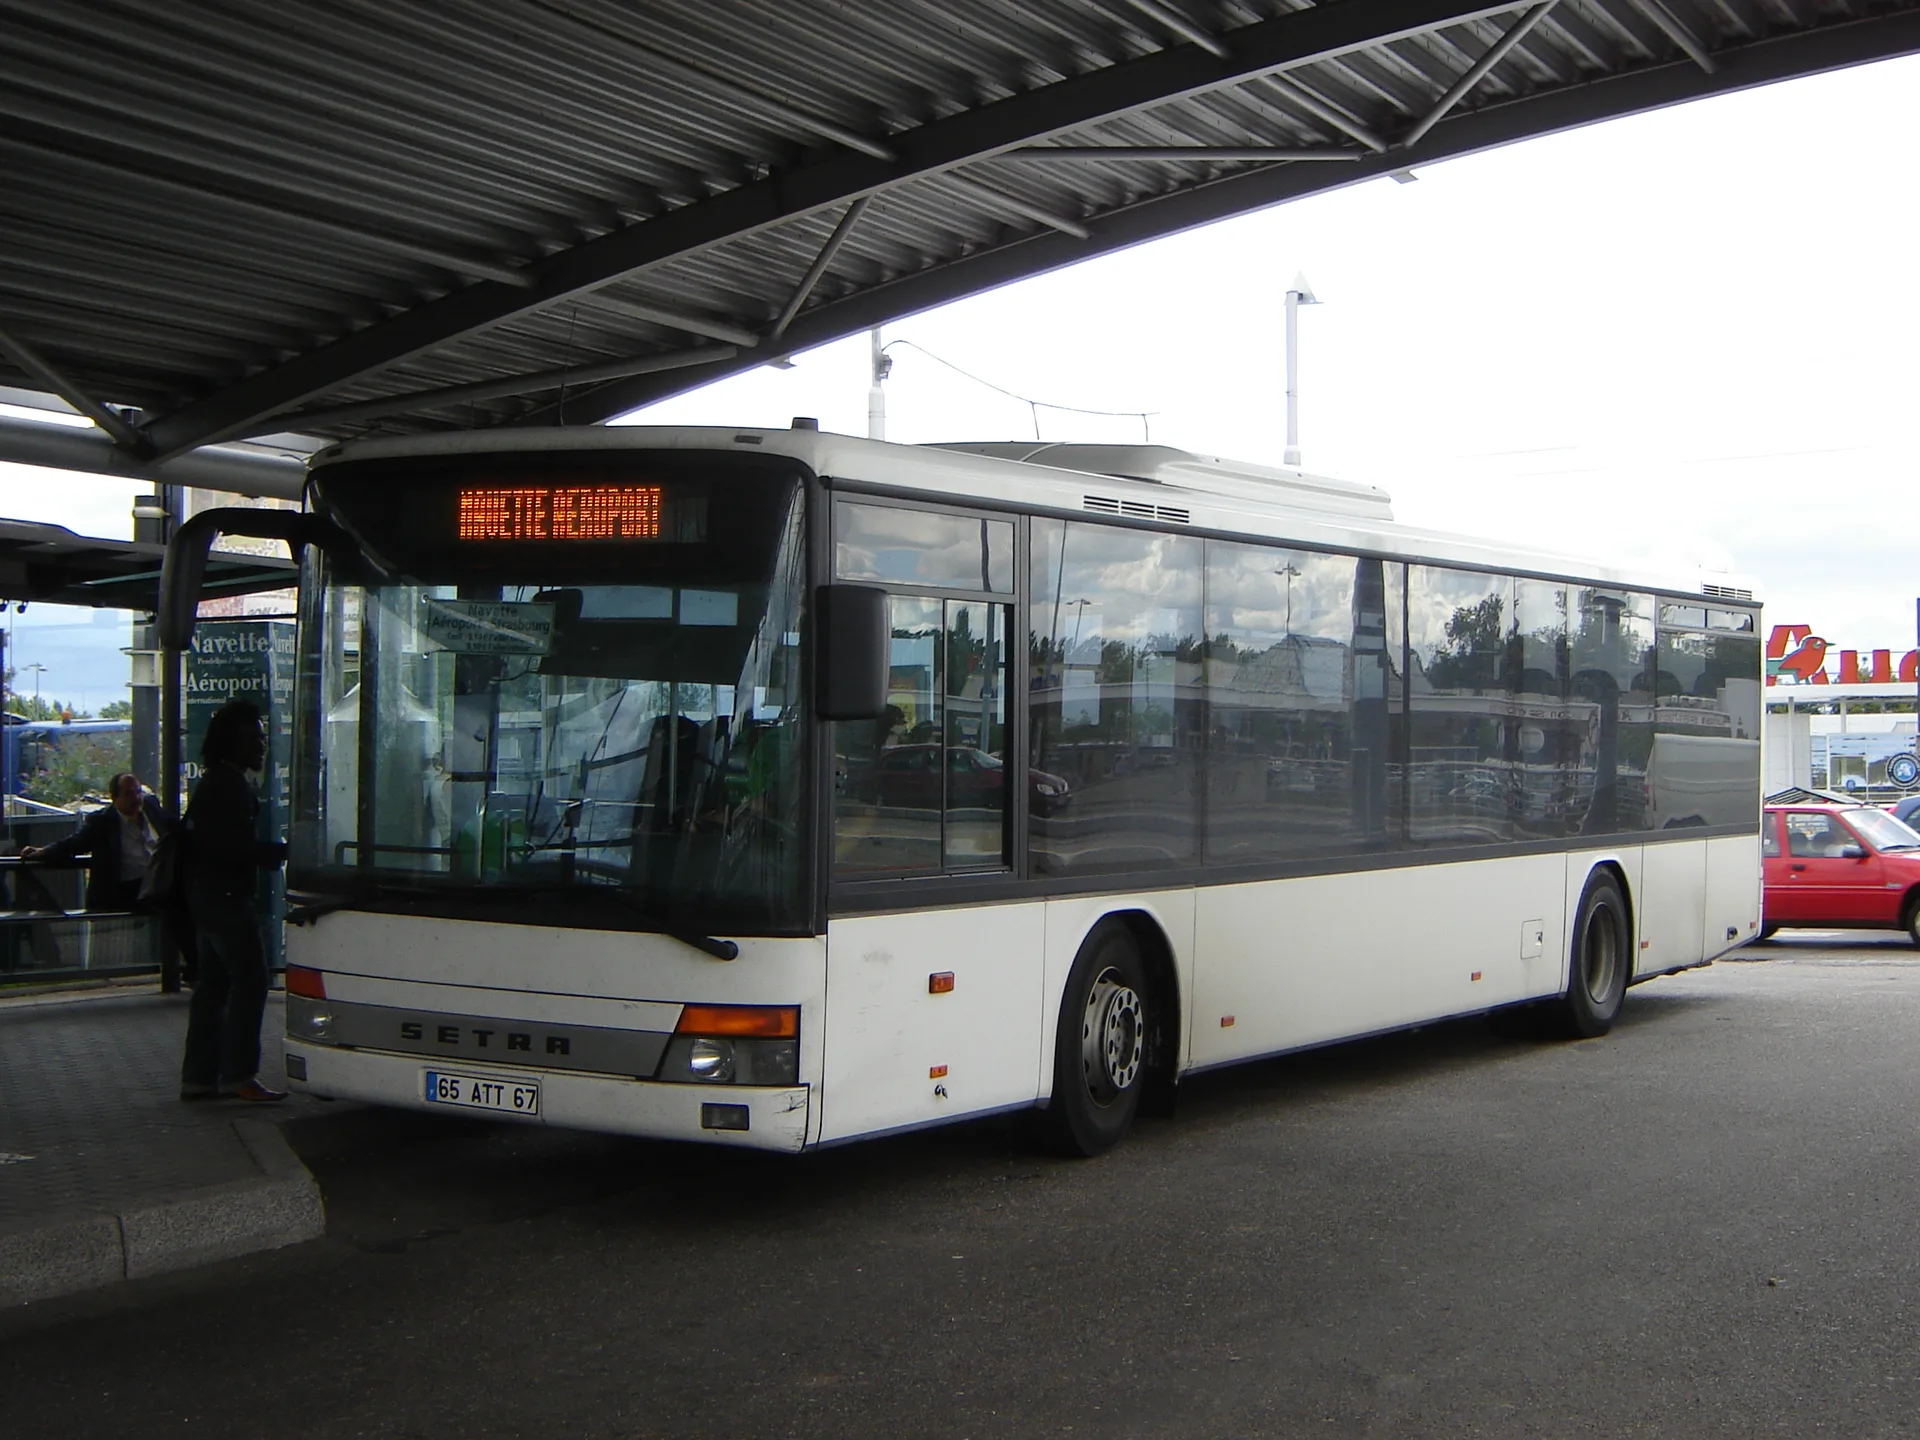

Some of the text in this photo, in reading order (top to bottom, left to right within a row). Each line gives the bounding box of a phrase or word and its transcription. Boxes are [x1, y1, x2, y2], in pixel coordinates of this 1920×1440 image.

[460, 486, 661, 539] NAVETTE AEROPORT
[468, 604, 518, 617] Navette
[191, 630, 269, 654] Navette
[187, 672, 269, 698] Aéroport
[401, 1022, 570, 1055] SETRA
[438, 1077, 460, 1100] 65
[471, 1082, 505, 1106] ATT
[514, 1087, 537, 1110] 67
